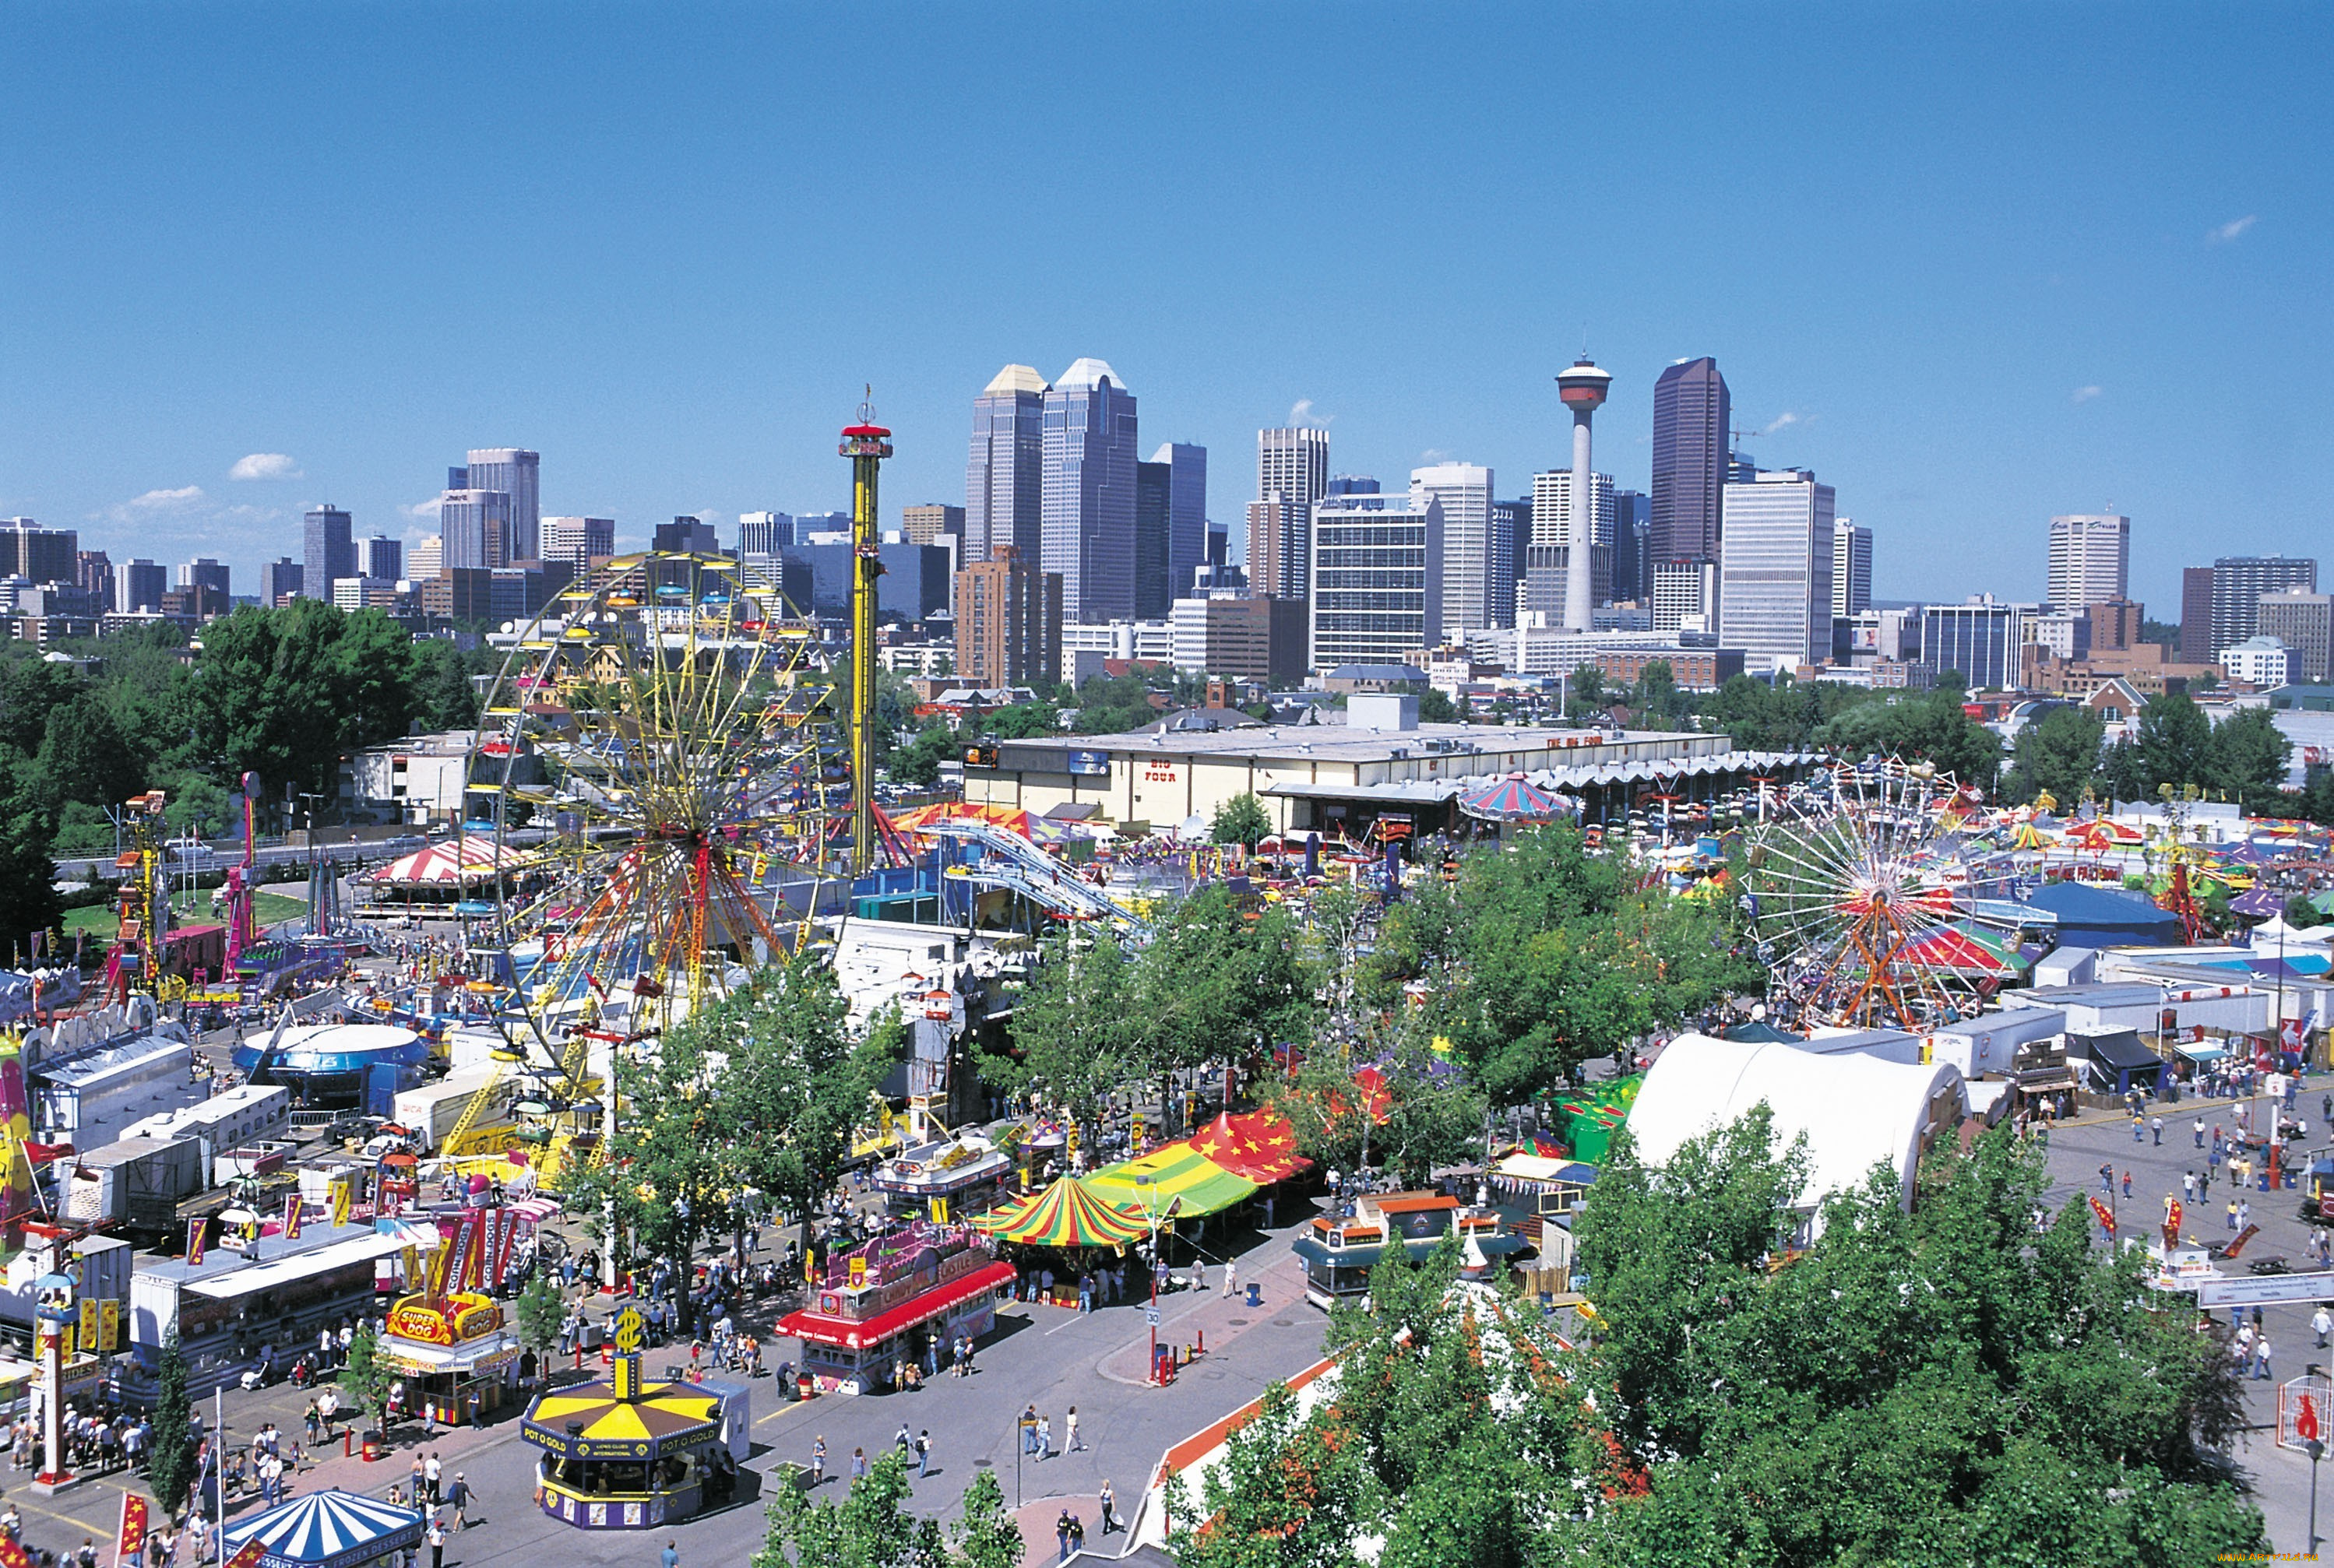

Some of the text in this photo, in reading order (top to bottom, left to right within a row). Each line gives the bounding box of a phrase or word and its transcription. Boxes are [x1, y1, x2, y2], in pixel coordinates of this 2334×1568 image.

[1150, 759, 1171, 769] BIG
[1145, 772, 1176, 782] FOUR
[484, 1215, 496, 1281] CORN DOGS
[449, 1226, 471, 1289] CORN DOGS
[400, 1312, 436, 1328] SUPER
[463, 1308, 495, 1327] SUPER
[1148, 1313, 1159, 1323] 30
[407, 1323, 432, 1337] DOG
[467, 1319, 491, 1336] DOG
[524, 1428, 567, 1452] POT O GOLD
[661, 1429, 715, 1452] POT O GOLD
[333, 1531, 414, 1567] FROZEN DESSERT
